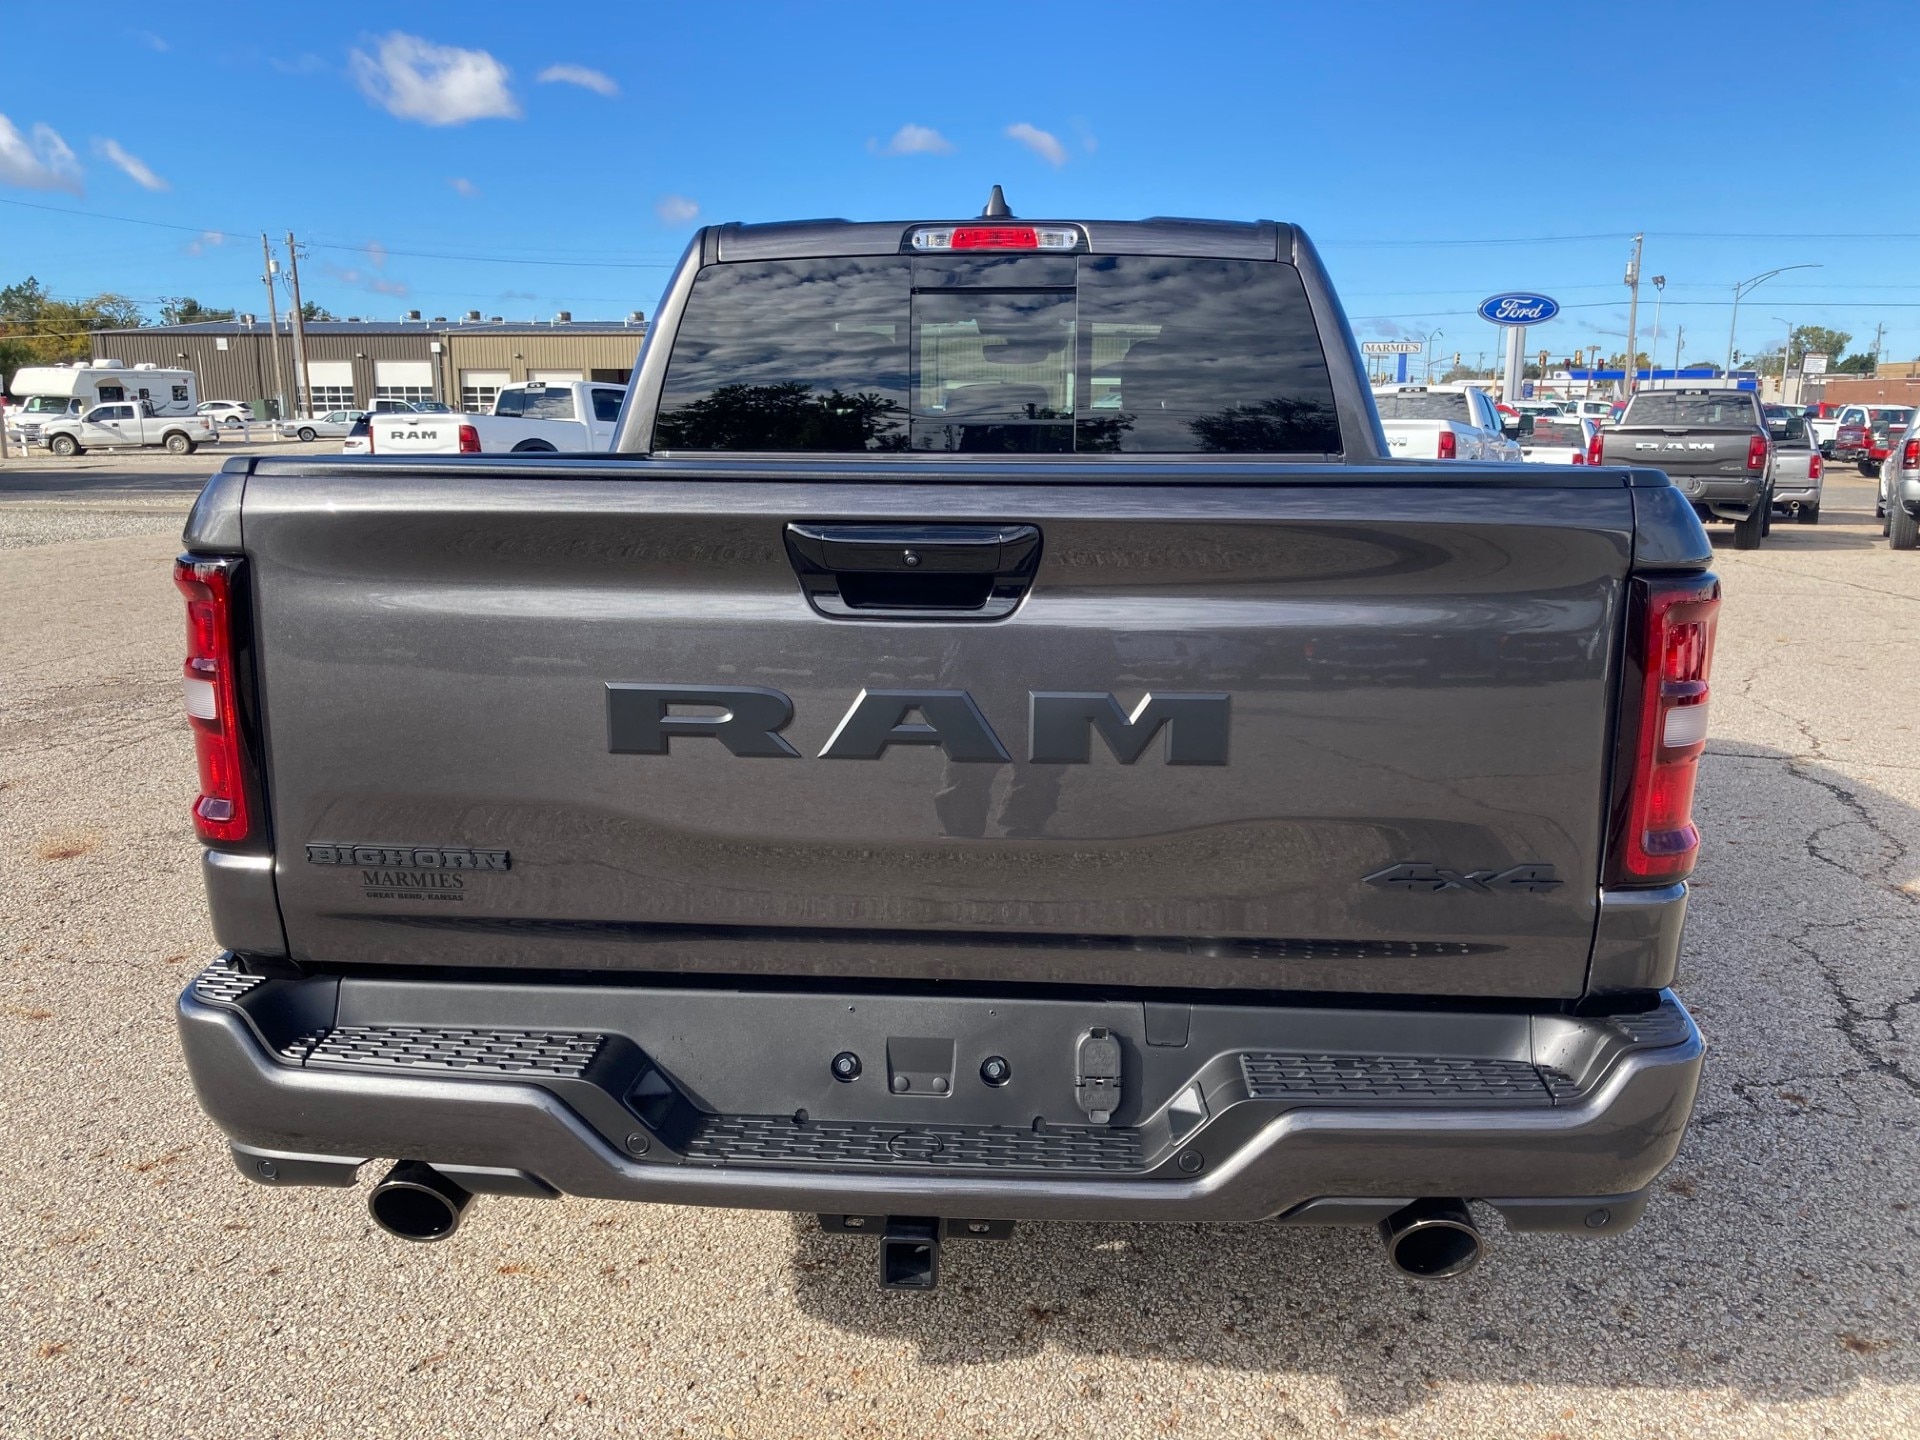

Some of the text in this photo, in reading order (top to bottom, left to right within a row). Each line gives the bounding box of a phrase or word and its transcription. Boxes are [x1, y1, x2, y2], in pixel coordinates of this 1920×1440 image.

[1495, 298, 1544, 318] Ford
[390, 431, 437, 439] RAM
[1635, 442, 1715, 452] RAM
[605, 682, 1230, 767] RAM
[361, 870, 464, 889] MARMIES
[366, 891, 395, 899] GREAT
